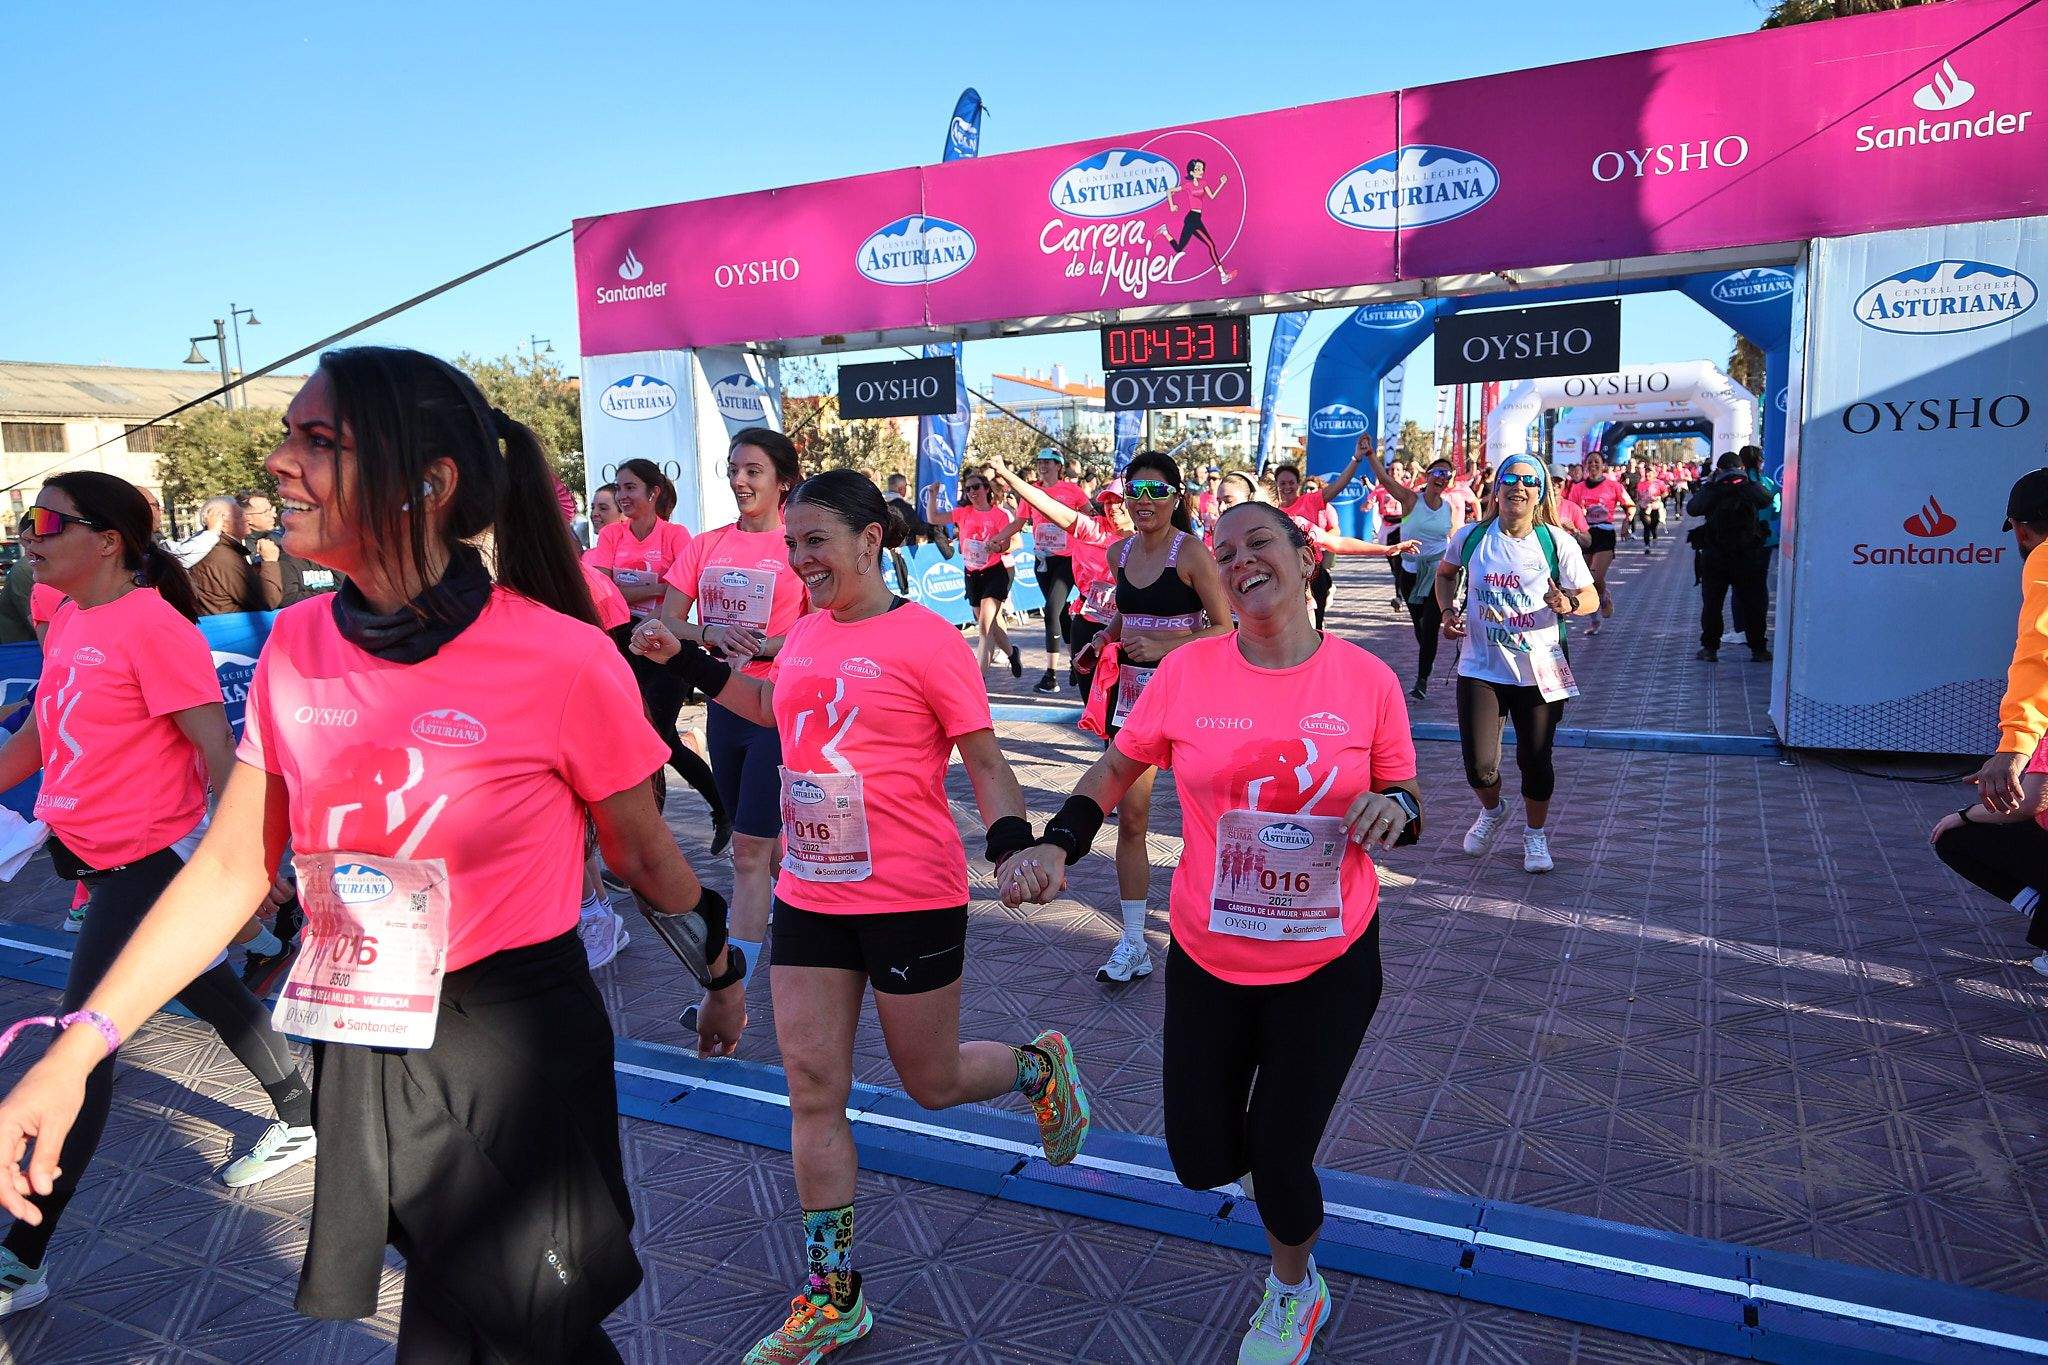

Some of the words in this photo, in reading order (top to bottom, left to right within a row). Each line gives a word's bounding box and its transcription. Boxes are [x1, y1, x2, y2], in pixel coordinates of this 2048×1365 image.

[1855, 111, 2033, 153] Santander
[1591, 136, 1749, 182] OYSHO
[1424, 166, 1479, 180] LECHERA
[1060, 176, 1169, 205] ASTURIANA
[1340, 177, 1485, 215] ASTURIANA
[1039, 218, 1146, 255] Carrera
[866, 244, 967, 272] ASTURIANA
[714, 257, 800, 288] OYSHO
[1065, 254, 1086, 278] de
[1088, 251, 1104, 276] la
[1100, 241, 1186, 299] Mujer
[596, 281, 667, 305] Santander
[1895, 286, 1951, 297] CENTRAL
[1958, 281, 2018, 292] LECHERA
[1866, 291, 2023, 321] ASTURIANA
[1461, 327, 1593, 364] OYSHO
[855, 375, 939, 403] OYSHO
[1111, 371, 1245, 406] OYSHO
[1564, 371, 1670, 398] OYSHO
[606, 394, 672, 411] ASTURIANA
[1842, 394, 2031, 434] OYSHO
[1632, 419, 1695, 430] VOLVO
[1852, 542, 2007, 565] Santander
[722, 598, 747, 611] 016
[1124, 616, 1152, 627] NIKE
[1154, 617, 1195, 628] PRO
[295, 705, 358, 728] OYSHO
[1195, 716, 1254, 730] OYSHO
[795, 820, 831, 841] 016
[1262, 830, 1310, 845] ASTURIANA
[803, 842, 820, 852] 2022
[822, 867, 858, 876] Santander
[1260, 869, 1311, 893] 016
[1228, 903, 1256, 914] CARRERA
[1276, 910, 1298, 918] MUJER
[1302, 910, 1328, 918] VALENCIA
[1269, 896, 1293, 907] 2021
[1225, 917, 1267, 932] OYSHO
[1293, 926, 1327, 934] Santander
[332, 934, 379, 965] 016
[329, 972, 350, 987] 8500
[286, 1006, 319, 1026] OYSHO
[347, 1018, 409, 1034] Santander
